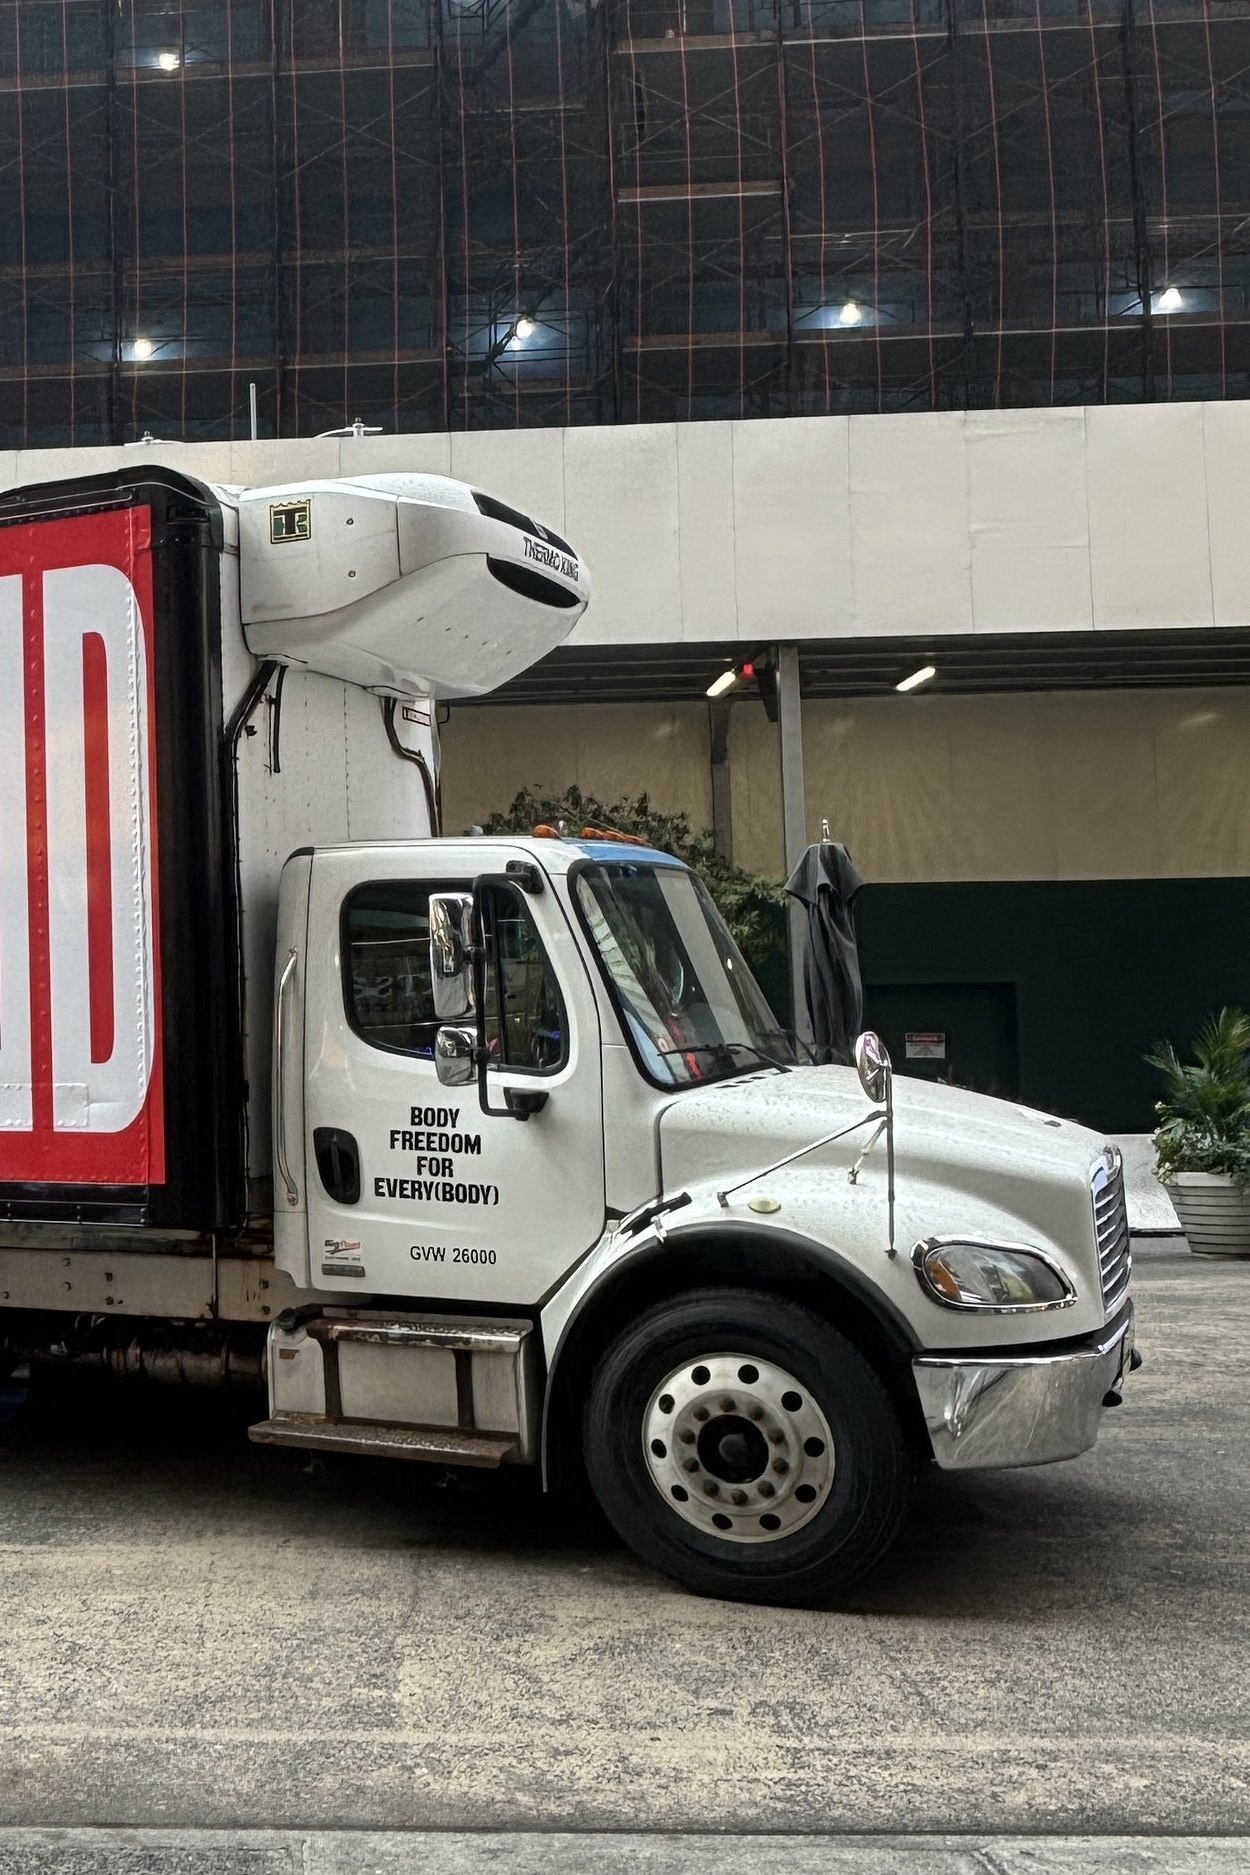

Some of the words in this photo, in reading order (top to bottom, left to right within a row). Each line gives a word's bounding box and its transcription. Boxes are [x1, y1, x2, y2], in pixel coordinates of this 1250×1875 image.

[410, 1106, 460, 1128] BODY
[389, 1130, 482, 1155] FREEDOM
[416, 1156, 454, 1178] FOR
[374, 1178, 499, 1206] EVERY(BODY)
[410, 1246, 446, 1262] GVW
[452, 1247, 497, 1265] 26000
